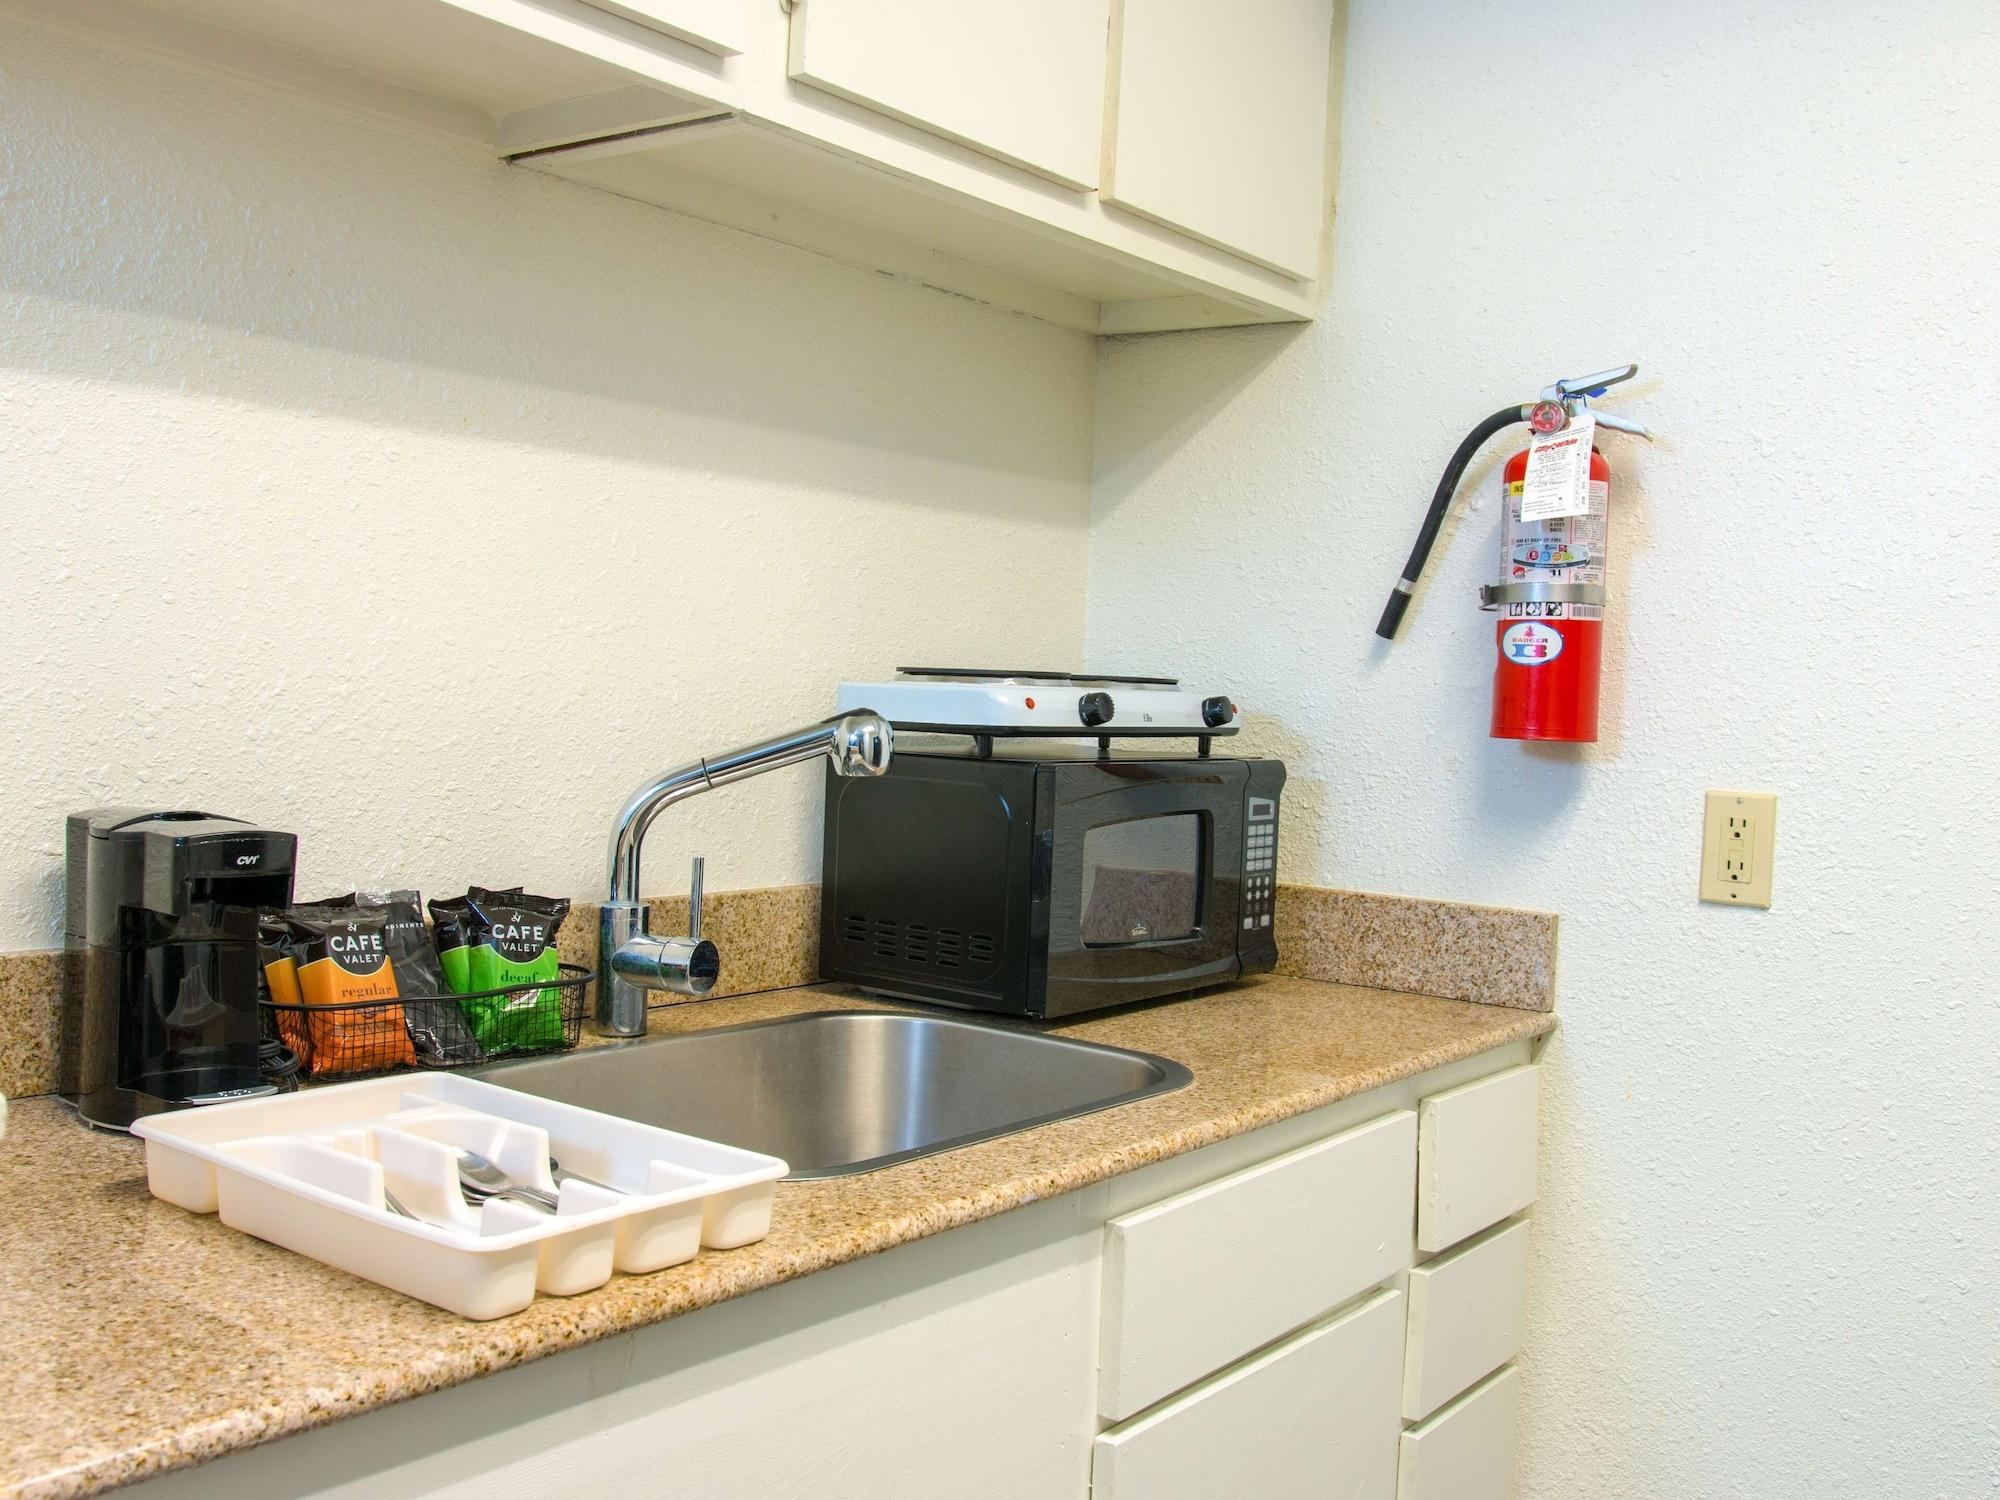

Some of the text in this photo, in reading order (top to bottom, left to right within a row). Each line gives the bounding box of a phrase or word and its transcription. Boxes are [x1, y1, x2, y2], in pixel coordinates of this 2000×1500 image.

[501, 942, 537, 953] VALET
[343, 954, 378, 964] VALET
[500, 969, 539, 984] decaf
[341, 982, 392, 999] regular
